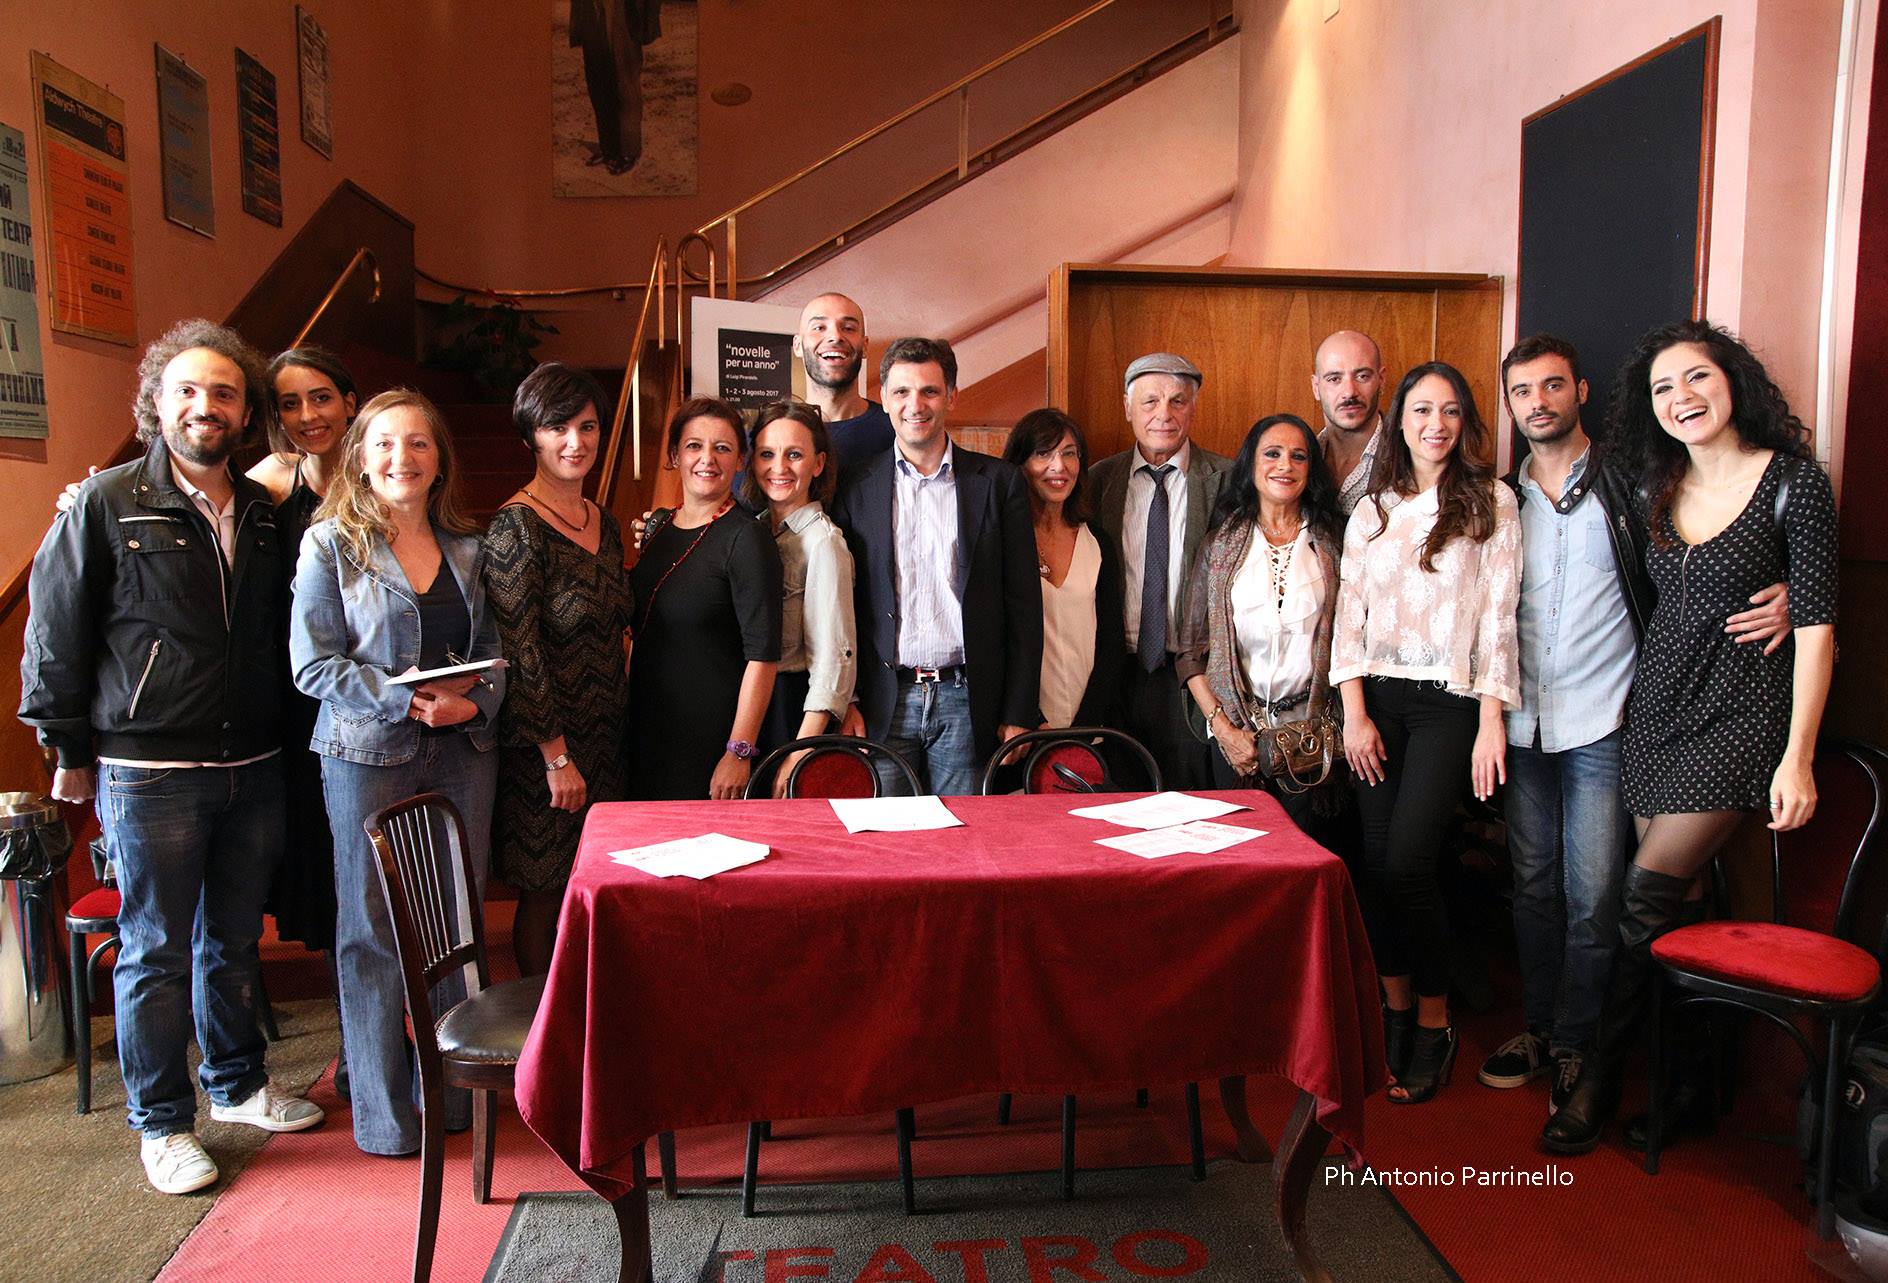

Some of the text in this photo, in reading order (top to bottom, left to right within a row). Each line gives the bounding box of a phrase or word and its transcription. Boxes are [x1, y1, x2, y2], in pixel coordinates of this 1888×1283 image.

[725, 359, 741, 369] per
[742, 360, 753, 368] un
[733, 387, 738, 395] 2
